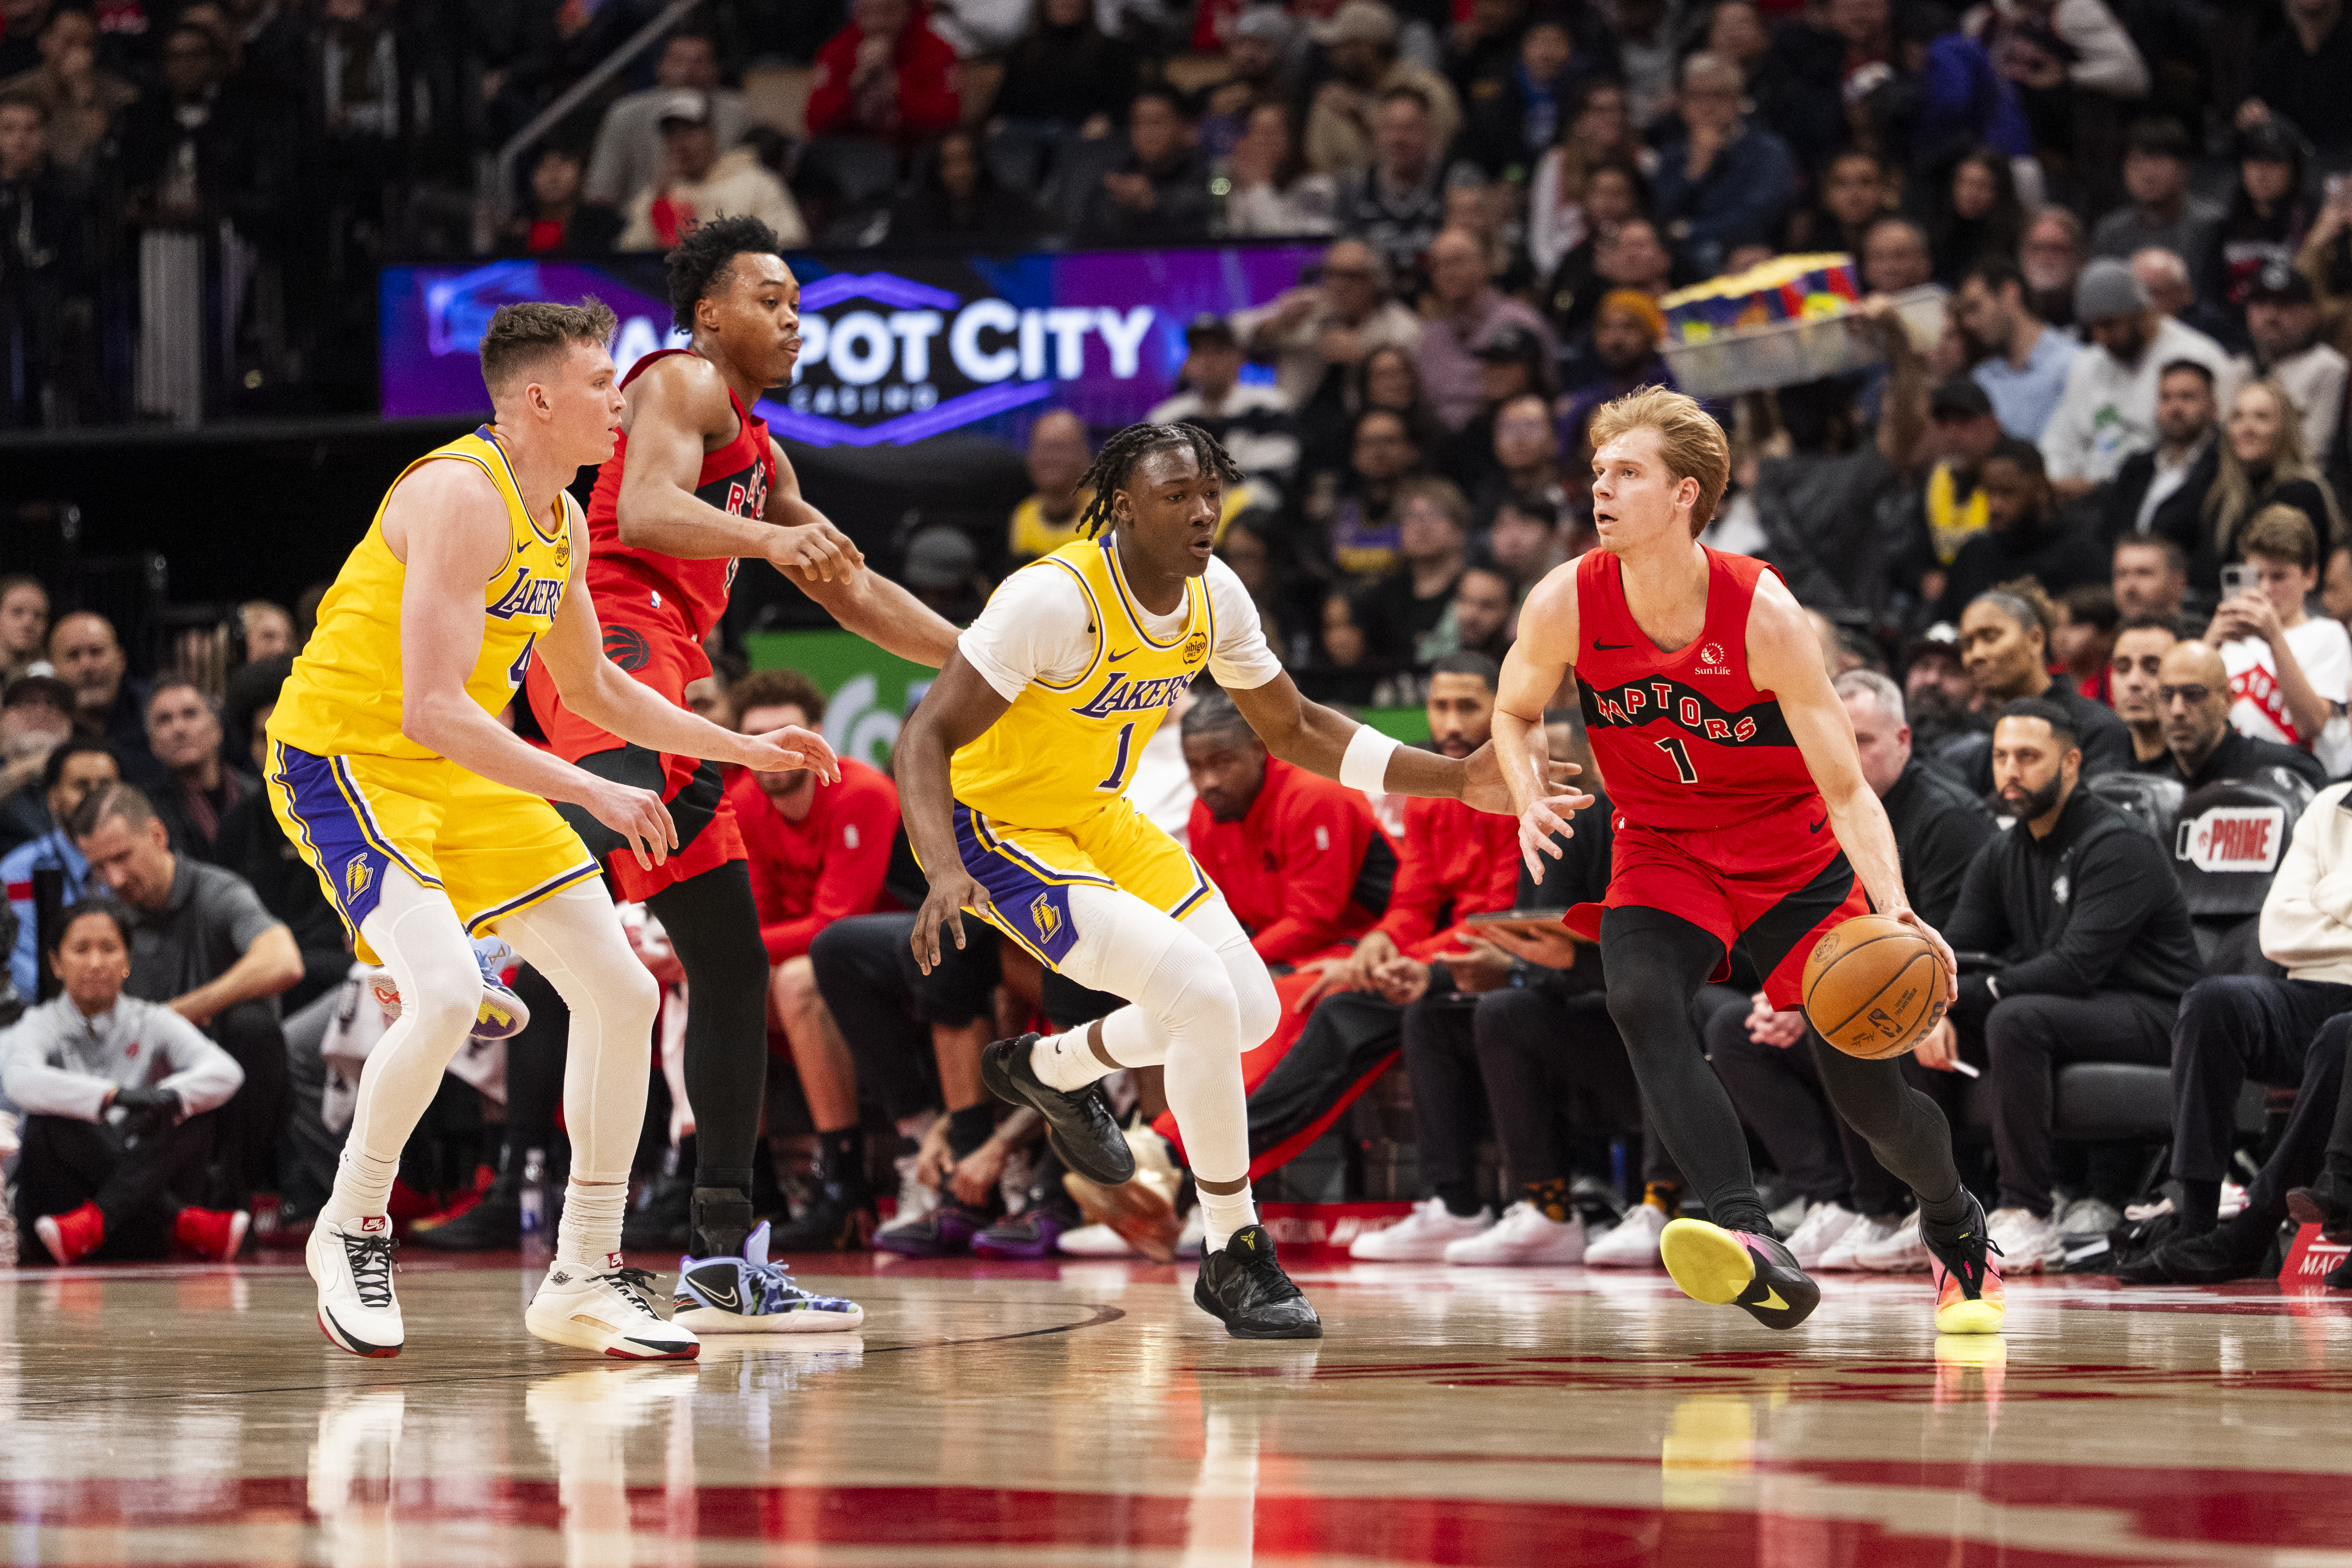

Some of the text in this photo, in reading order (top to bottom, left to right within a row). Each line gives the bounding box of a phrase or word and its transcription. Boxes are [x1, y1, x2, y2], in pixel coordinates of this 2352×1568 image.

[948, 298, 1155, 383] CITY
[788, 384, 940, 416] CASINO
[486, 565, 564, 625] LAKERS
[506, 631, 536, 689] 4
[1185, 641, 1205, 653] bibigo
[1695, 666, 1731, 675] Sun Life
[1069, 670, 1196, 720] LAKERS
[1593, 682, 1756, 742] RAPTORS
[1094, 721, 1136, 793] 1
[1654, 737, 1698, 784] 1
[2208, 819, 2272, 861] PRIME
